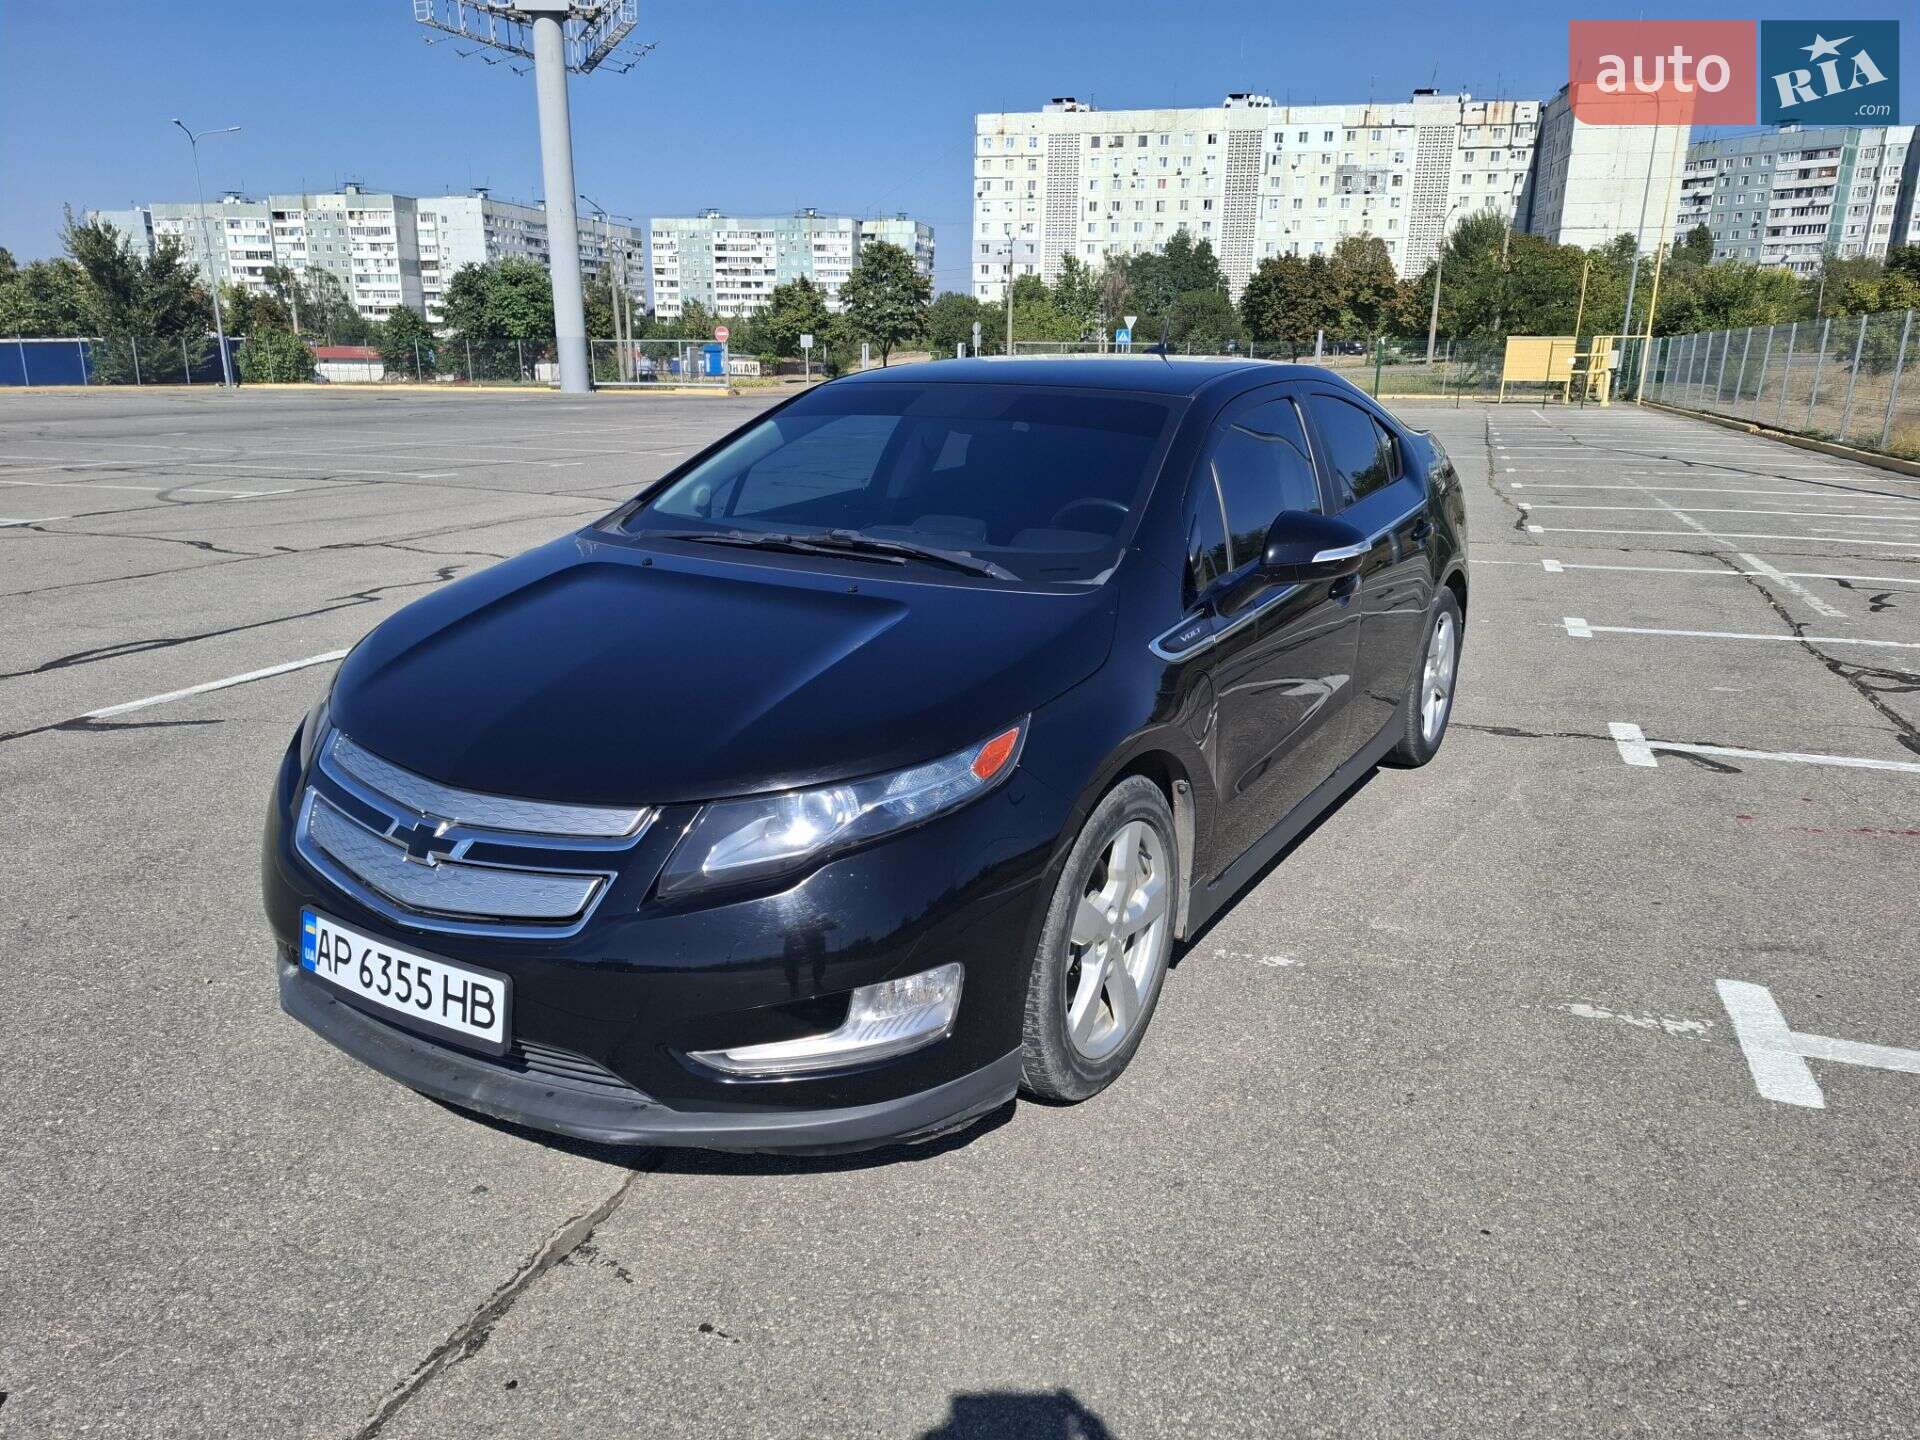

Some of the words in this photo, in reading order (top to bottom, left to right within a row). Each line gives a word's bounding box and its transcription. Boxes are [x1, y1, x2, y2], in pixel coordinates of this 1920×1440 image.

[317, 929, 352, 975] AP
[359, 949, 433, 1010] 6355
[442, 974, 496, 1029] HB
